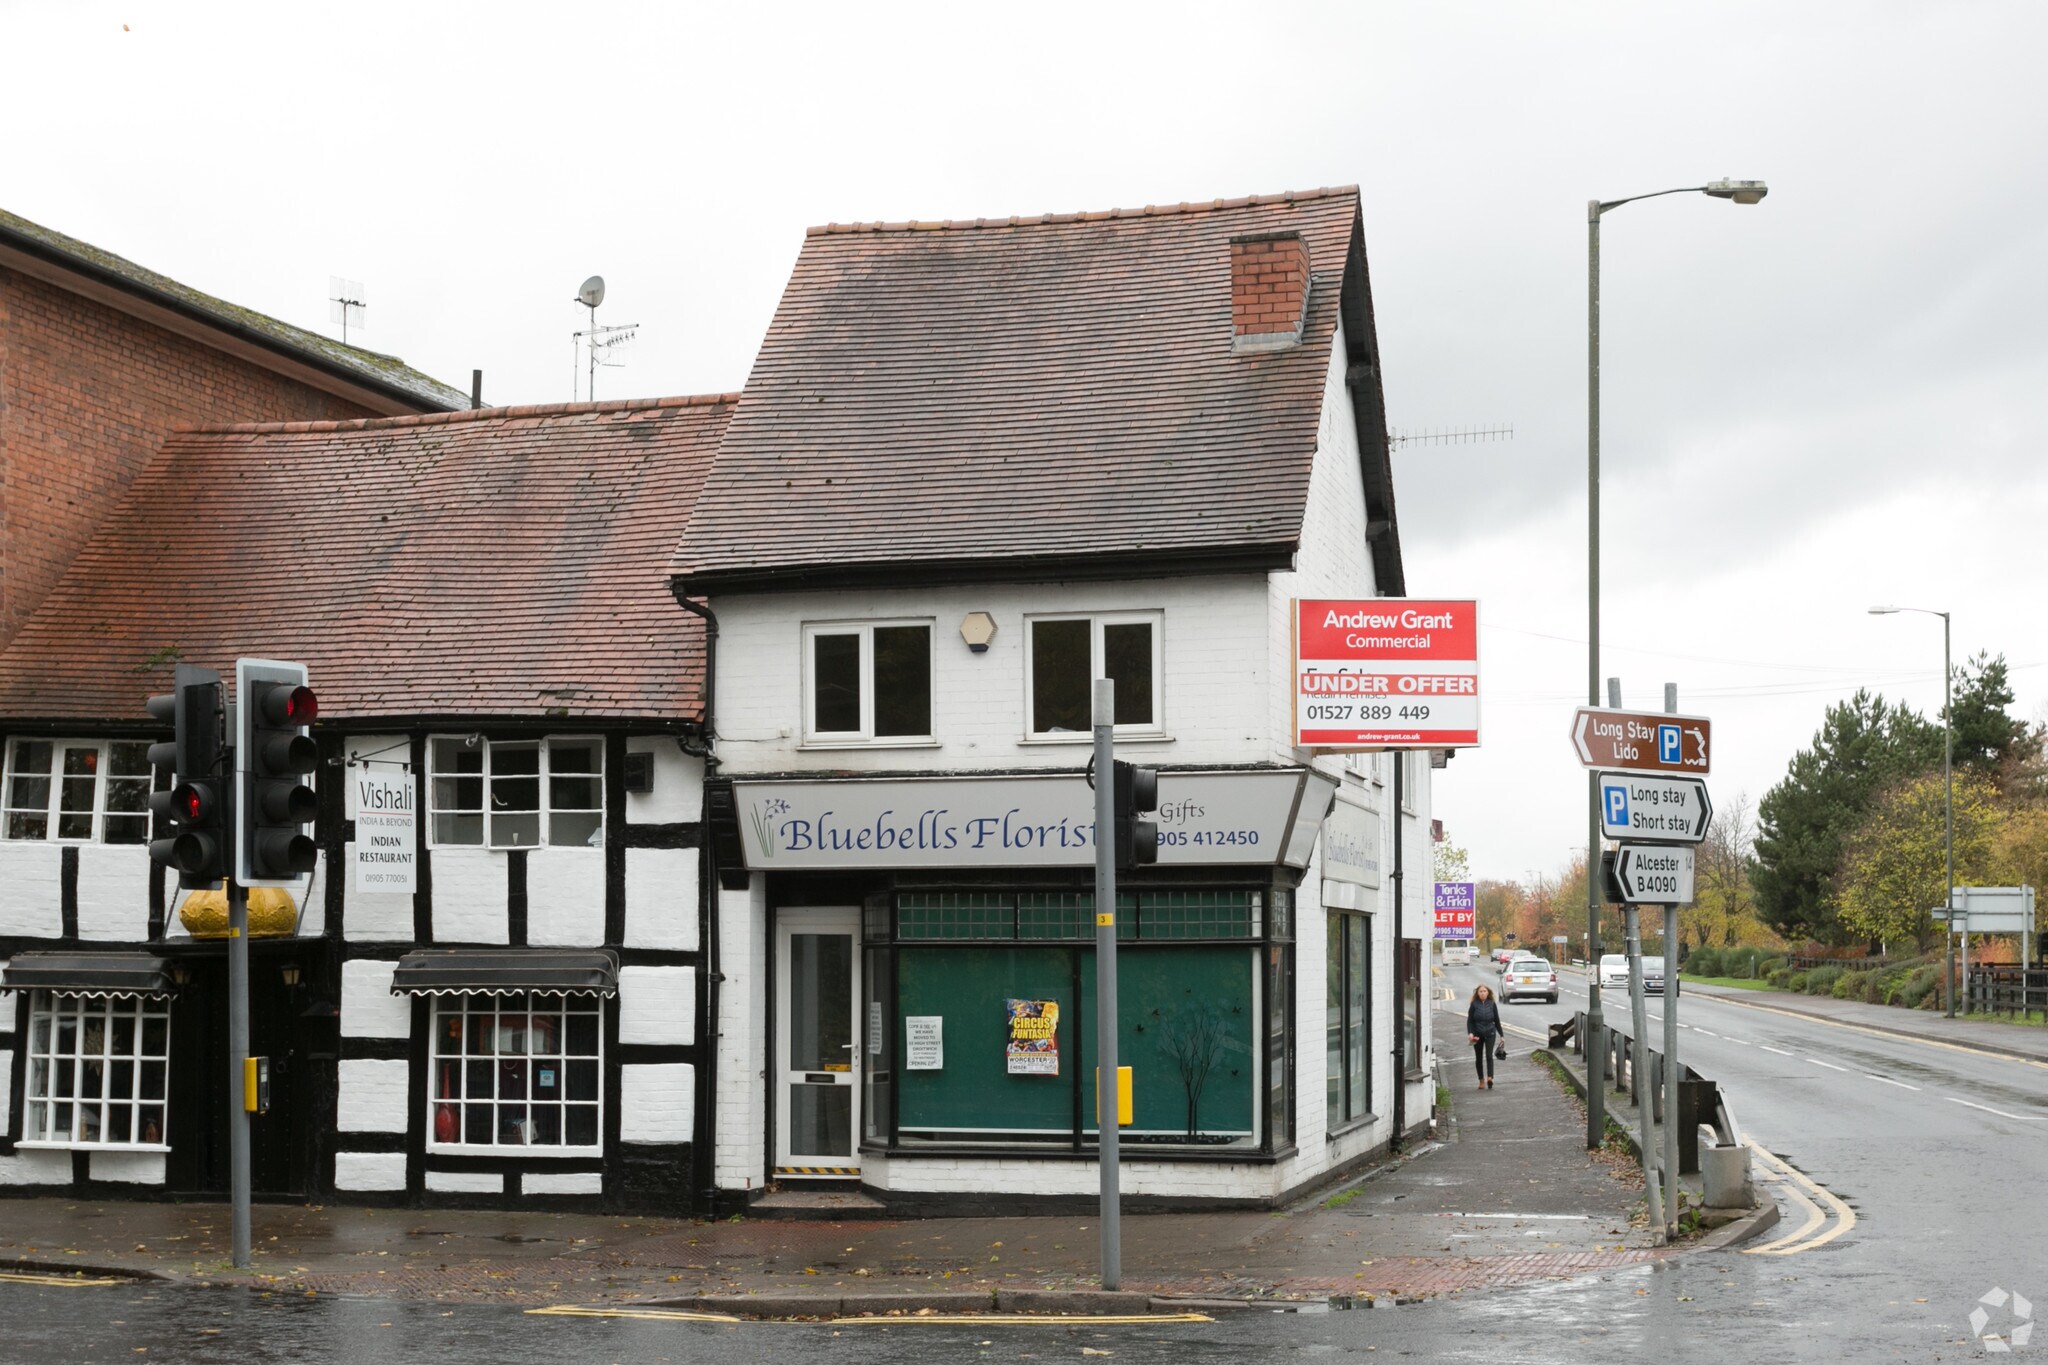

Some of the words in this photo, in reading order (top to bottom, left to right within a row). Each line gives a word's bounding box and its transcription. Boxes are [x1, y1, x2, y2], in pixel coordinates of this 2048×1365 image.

[1323, 609, 1398, 629] Andrew
[1400, 609, 1453, 629] Grant
[1346, 633, 1430, 648] Commercial
[1303, 675, 1389, 692] UNDER
[1398, 676, 1475, 693] OFFER
[1307, 705, 1353, 720] 01527
[1360, 705, 1391, 720] 889
[1398, 705, 1430, 720] 449
[1357, 733, 1420, 741] andrew-grant.co.uk
[1593, 718, 1623, 740] Long
[1628, 721, 1655, 743] Stay
[1613, 742, 1639, 760] Lido
[1664, 729, 1679, 760] P
[360, 781, 412, 810] Vishali
[1631, 784, 1659, 805] Long
[1662, 789, 1686, 807] stay
[1160, 798, 1205, 826] Gifts
[1609, 790, 1625, 822] P
[359, 817, 378, 826] INDIA
[380, 817, 385, 826] &
[386, 818, 412, 827] BEYOND
[780, 809, 958, 850] Bluebells
[1633, 812, 1665, 830] Short
[1668, 815, 1691, 834] stay
[371, 836, 401, 847] INDIAN
[1157, 831, 1188, 846] 905
[1194, 830, 1259, 846] 412450
[360, 852, 412, 863] RESTAURANT
[1636, 853, 1680, 871] Alcester
[1440, 884, 1467, 895] Tonks
[1436, 896, 1446, 907] &
[1447, 895, 1471, 907] Firkin
[1434, 912, 1455, 923] LET
[1457, 912, 1473, 923] BY
[1013, 1016, 1051, 1029] CIRCUS
[1012, 1029, 1051, 1040] FUNTASIA
